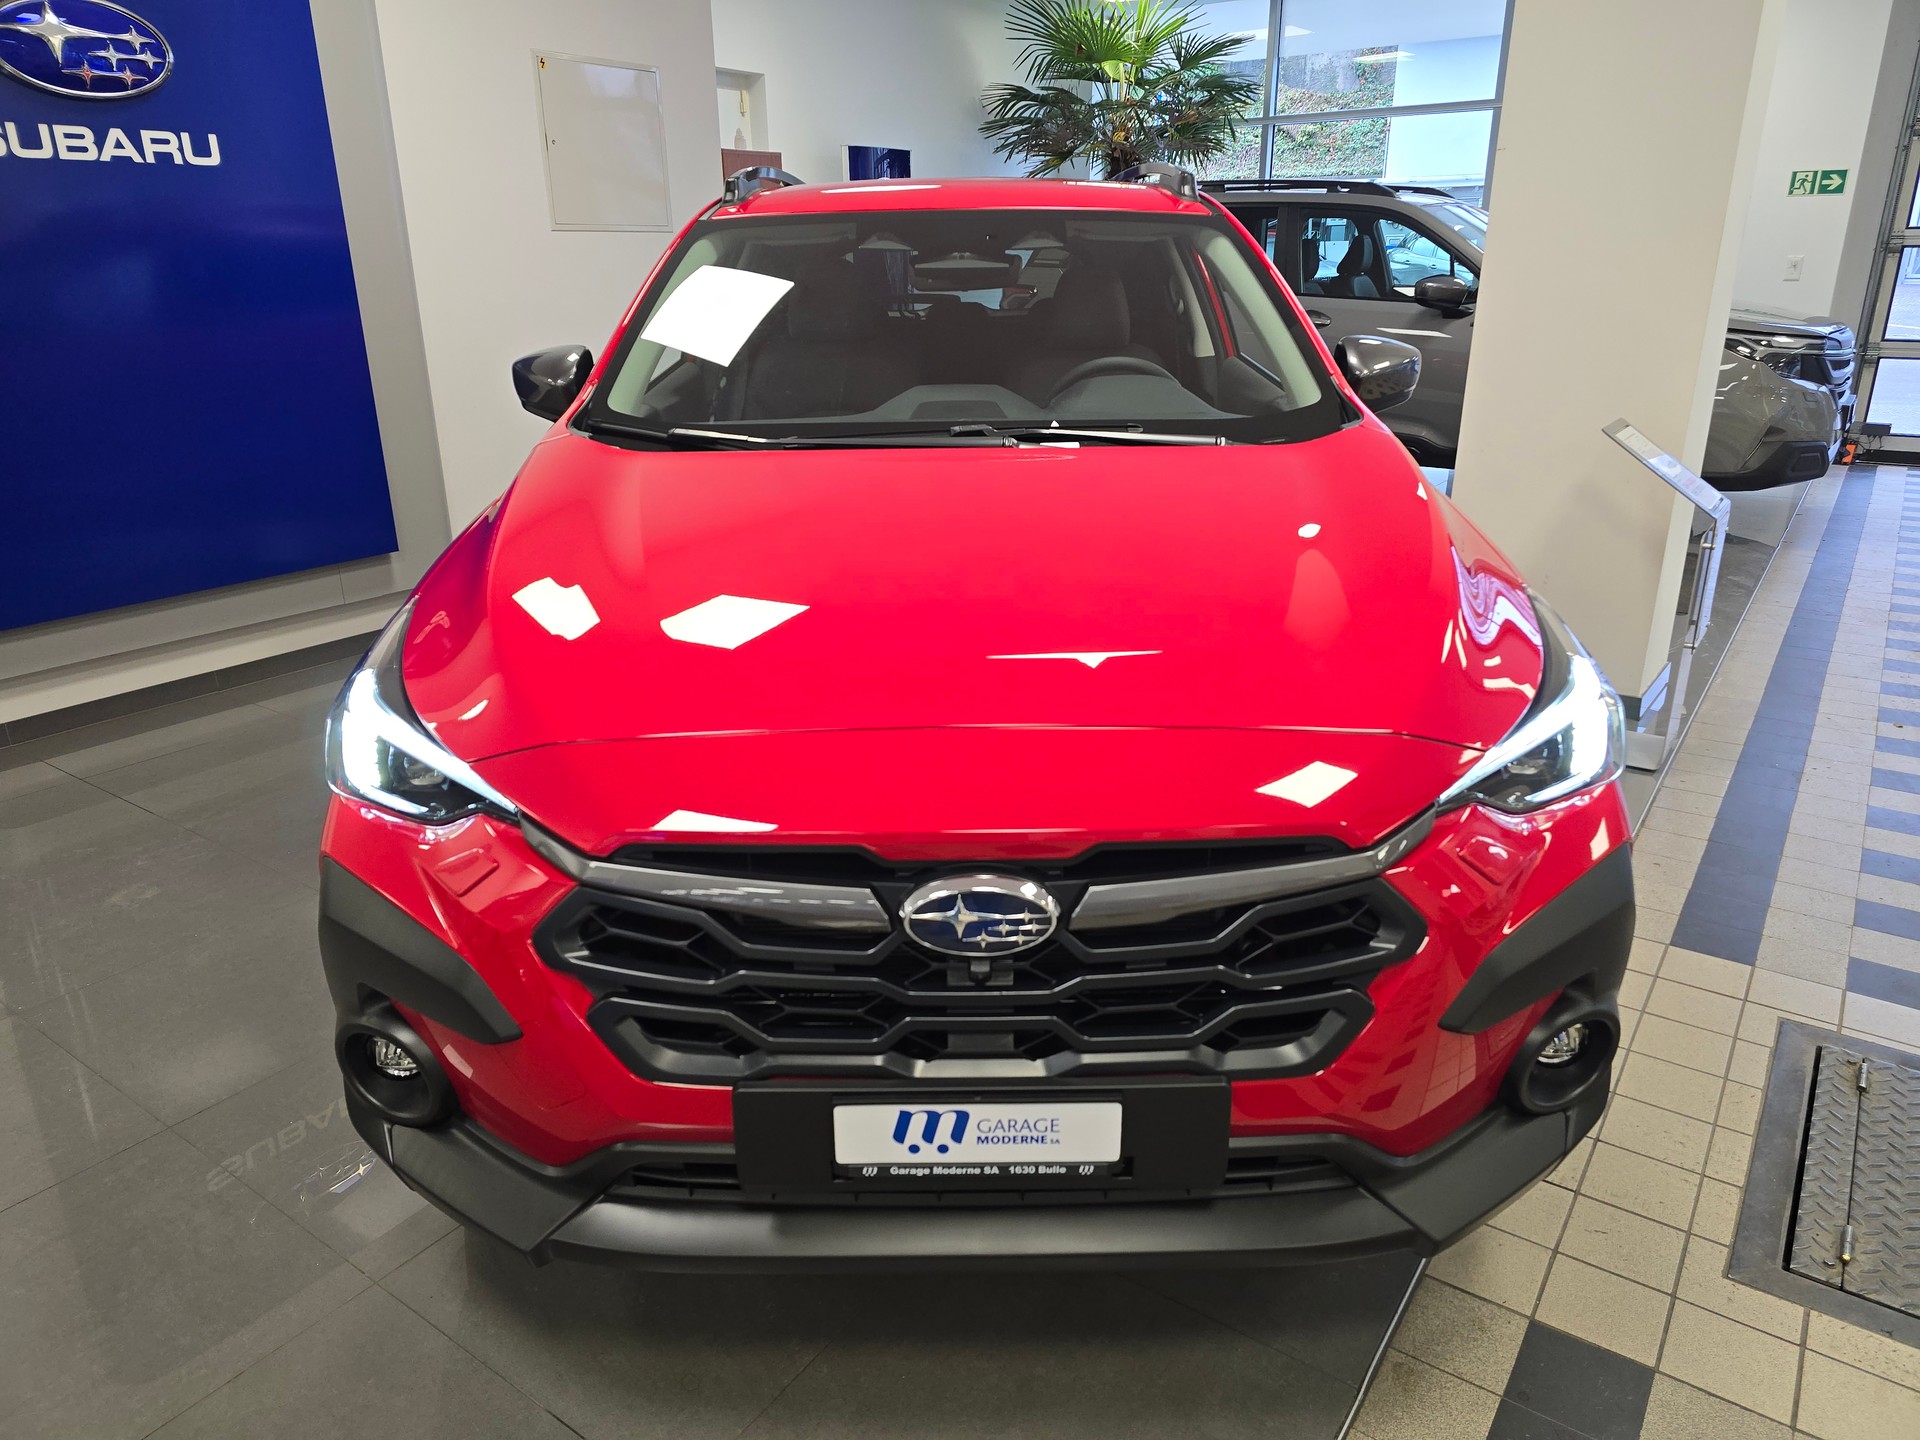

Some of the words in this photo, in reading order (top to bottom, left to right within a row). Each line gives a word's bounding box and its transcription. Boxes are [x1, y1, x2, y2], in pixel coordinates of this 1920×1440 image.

[0, 121, 221, 166] UBARU
[976, 1118, 1061, 1134] GARAGE
[976, 1135, 1048, 1145] MODERNE
[889, 1165, 931, 1177] Garage
[932, 1165, 981, 1175] Moderne
[983, 1165, 1000, 1175] SA
[1008, 1165, 1036, 1174] 1630
[1038, 1165, 1067, 1174] Bulle
